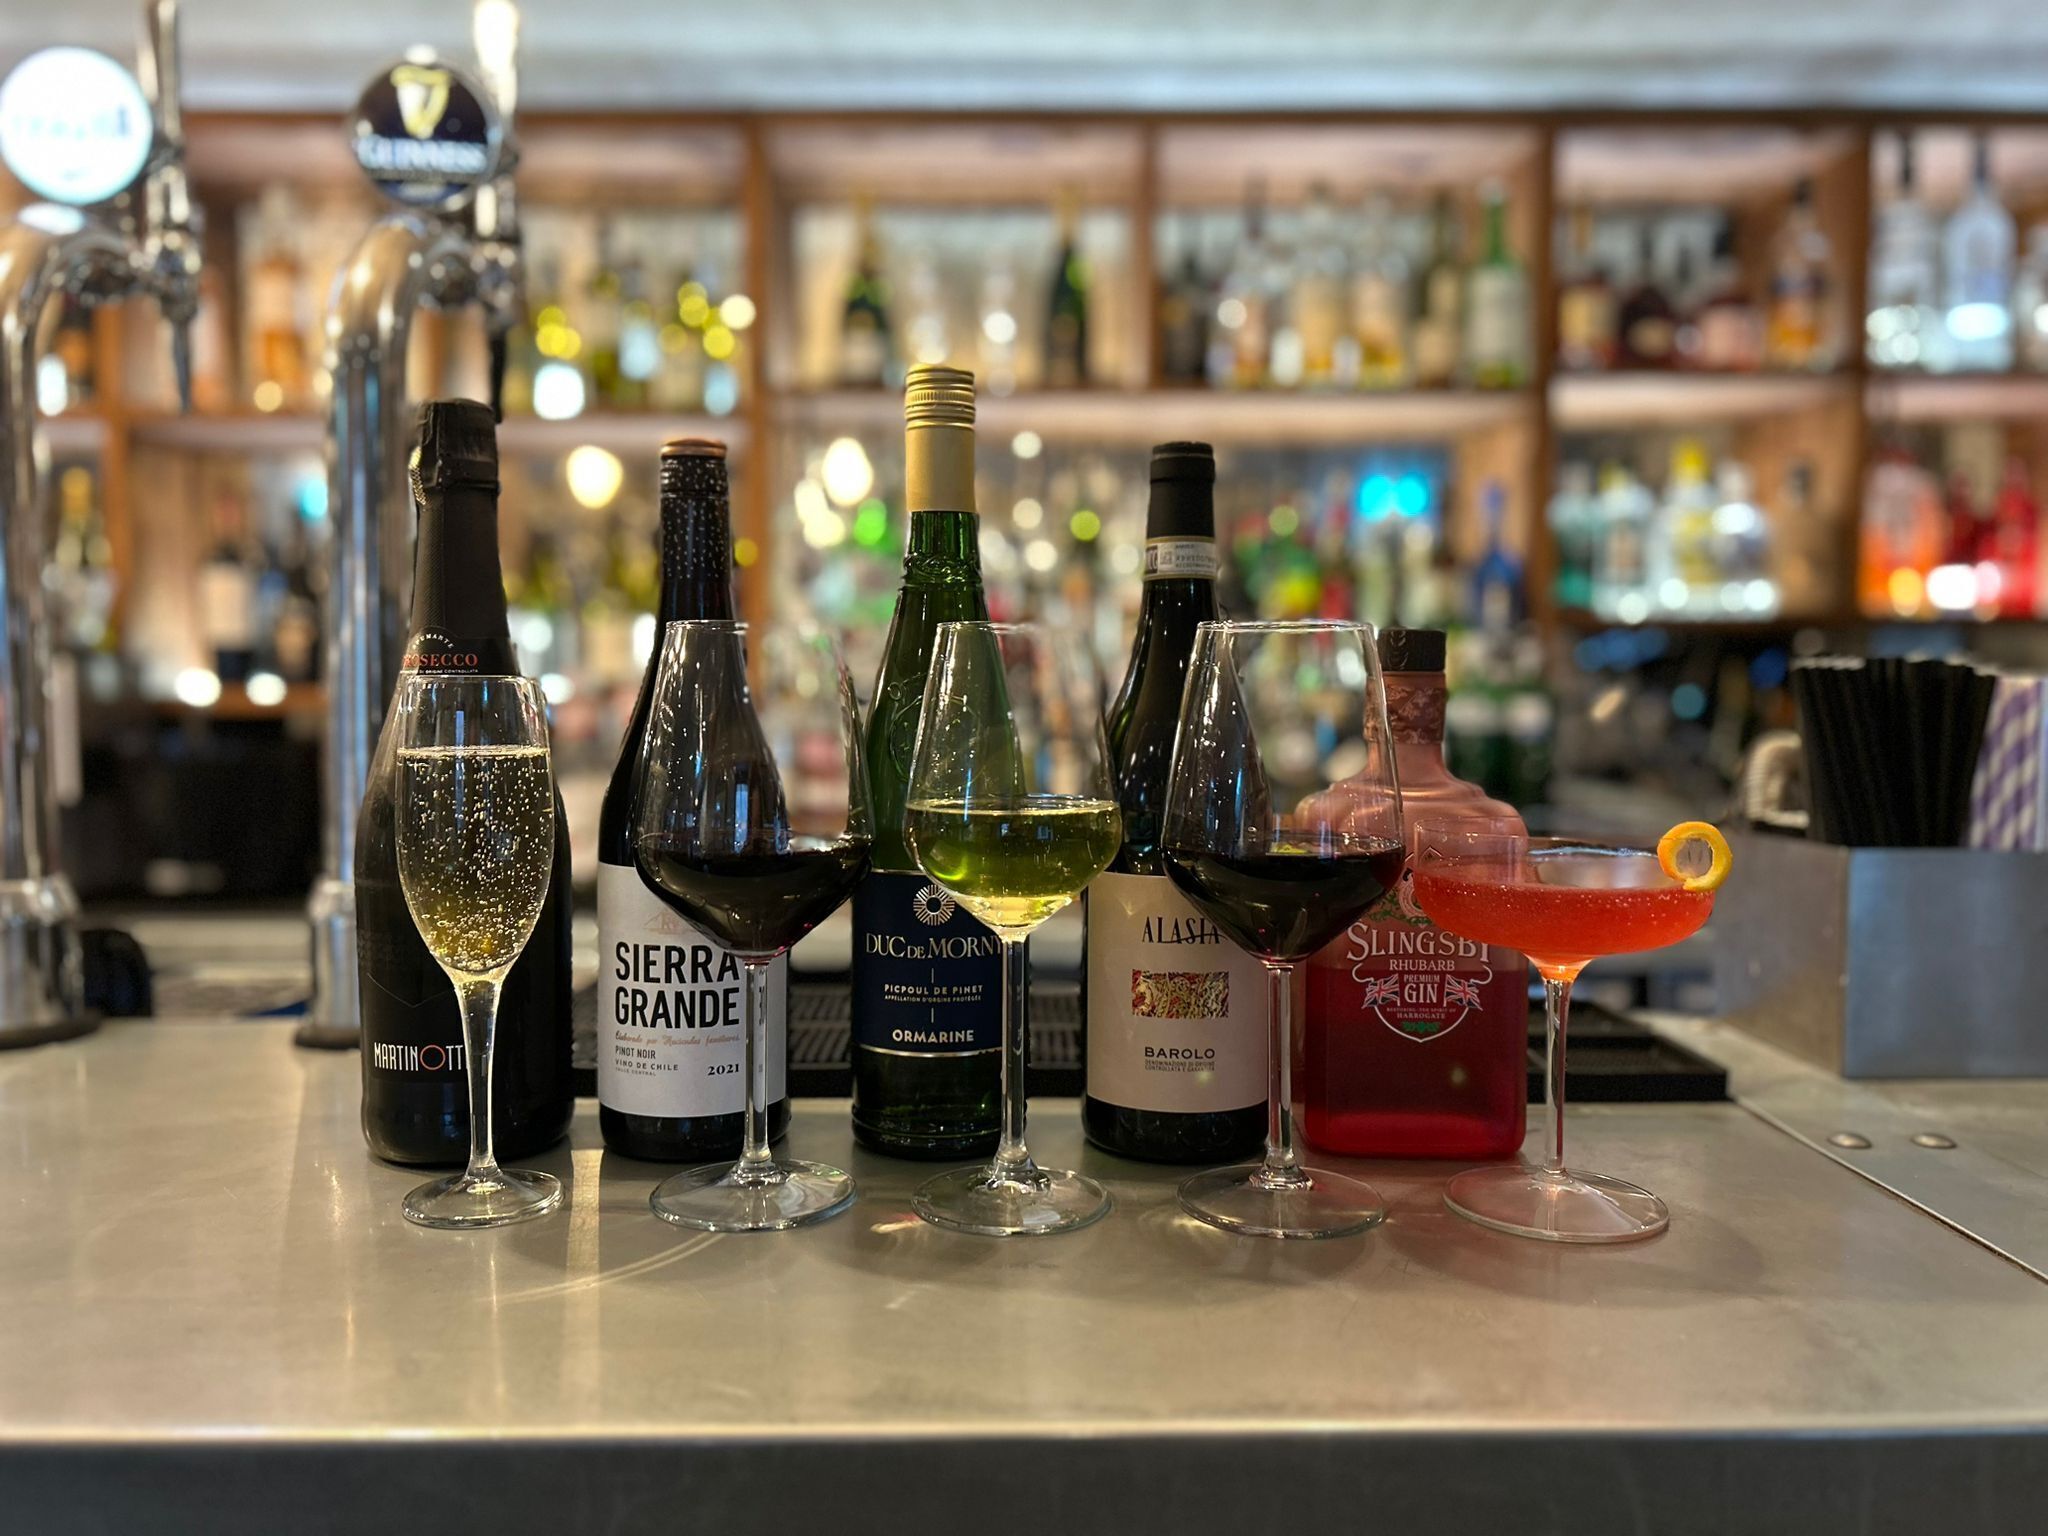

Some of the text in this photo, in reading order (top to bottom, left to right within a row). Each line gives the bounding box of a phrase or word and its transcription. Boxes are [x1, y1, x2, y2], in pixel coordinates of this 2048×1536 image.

[403, 653, 479, 668] ROSECCO
[1142, 916, 1221, 944] ALASIA
[866, 933, 906, 958] DUC
[907, 946, 926, 959] DE
[615, 941, 740, 984] SIERRA
[1389, 959, 1455, 971] RHUBARB
[1403, 974, 1440, 983] PREMIUM
[884, 984, 983, 995] PICPOUL DE PINET
[1404, 983, 1438, 1003] GIN
[615, 986, 740, 1029] GRANDE
[892, 1029, 975, 1044] ORMARINE
[615, 1045, 656, 1059] PINOT NOIR
[1144, 1046, 1216, 1060] BAROLO
[615, 1059, 679, 1071] VINO DE CHILE
[707, 1063, 740, 1076] 2021
